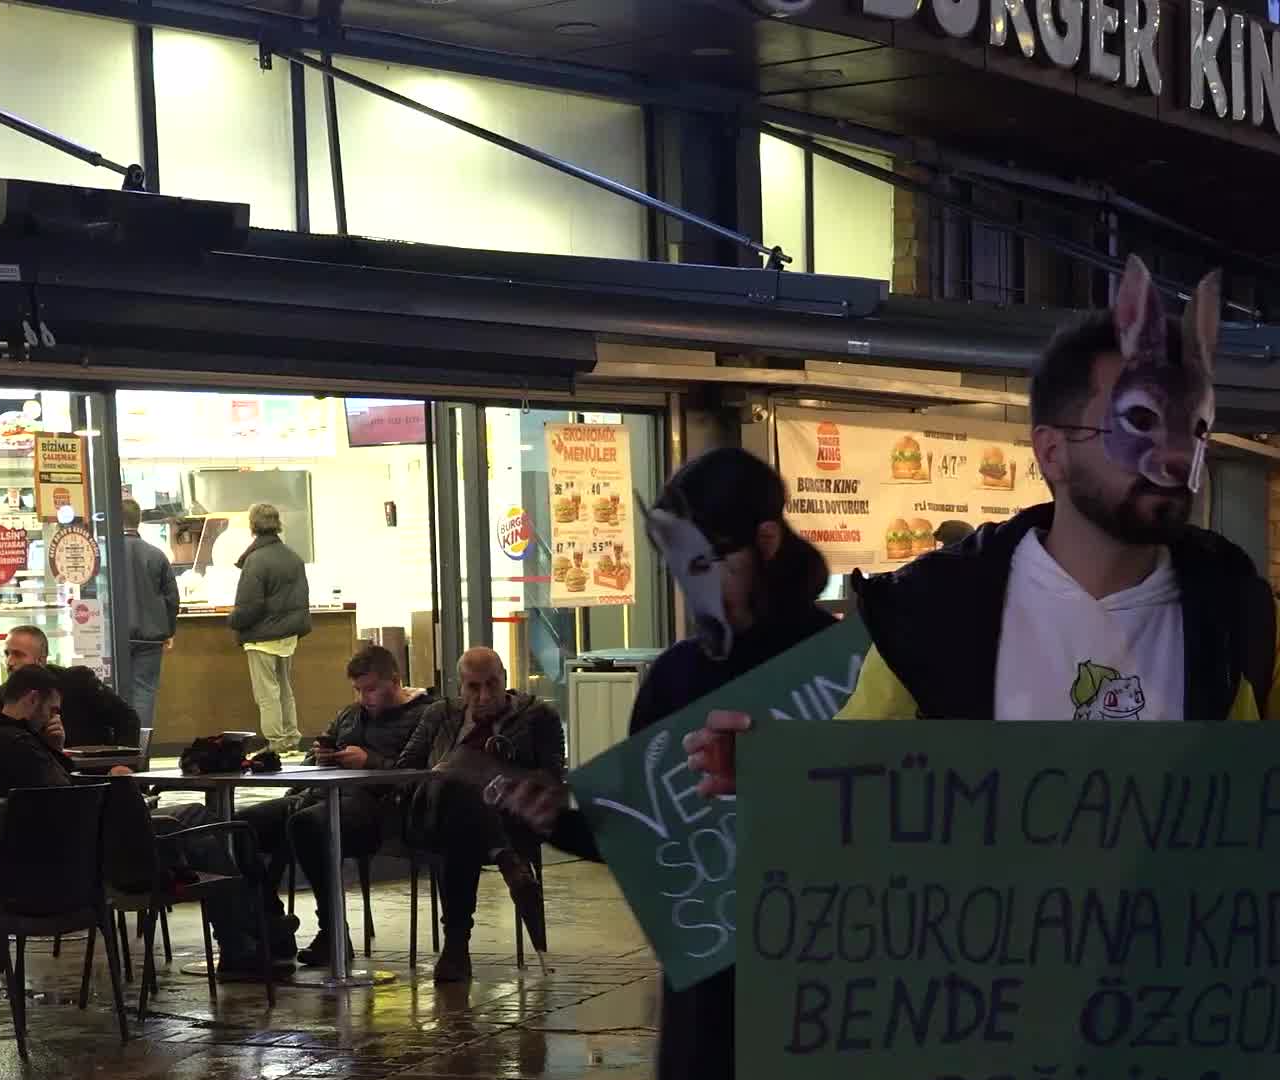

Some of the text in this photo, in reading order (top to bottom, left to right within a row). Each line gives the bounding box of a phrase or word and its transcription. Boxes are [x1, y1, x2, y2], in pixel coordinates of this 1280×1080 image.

[41, 440, 77, 453] BİZİMLE
[563, 444, 617, 462] MENÜLER
[817, 447, 841, 461] KING
[797, 477, 832, 493] BURGER
[808, 752, 1001, 846] TÜM
[783, 972, 1025, 1055] BENDE
